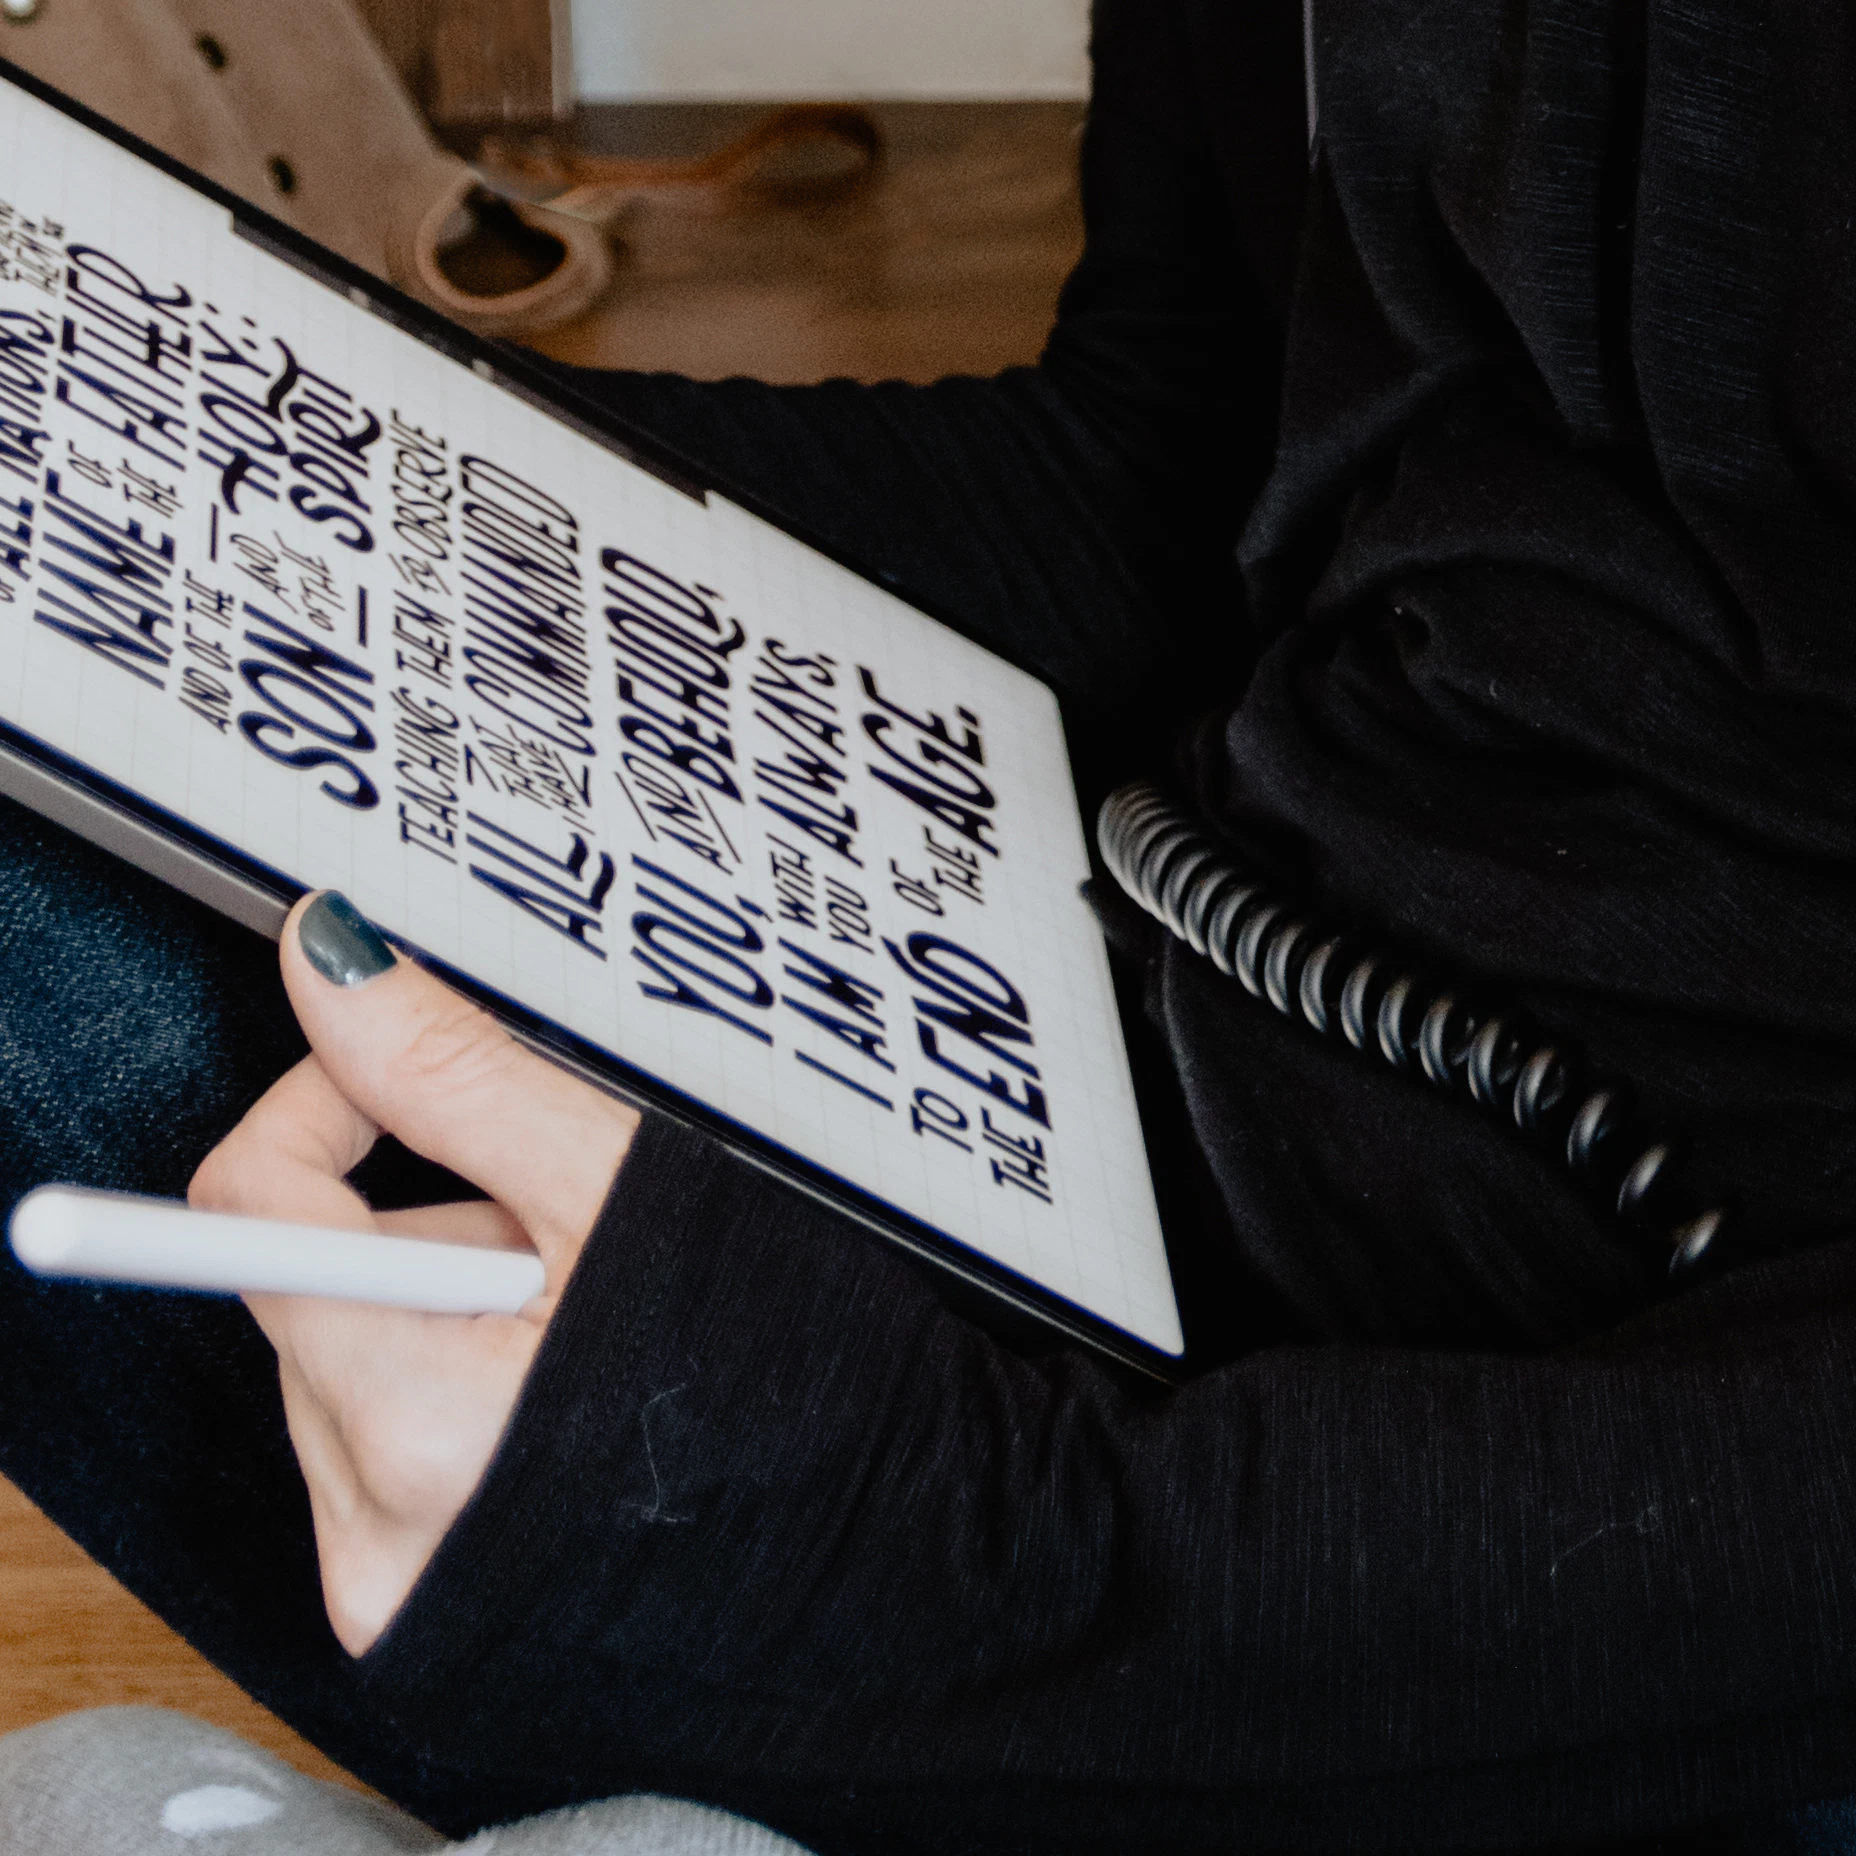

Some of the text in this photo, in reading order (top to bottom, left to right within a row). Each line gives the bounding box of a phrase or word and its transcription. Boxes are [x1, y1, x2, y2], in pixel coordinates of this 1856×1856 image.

[33, 243, 194, 692] NAME OF THE FATHER
[389, 408, 453, 562] OBSERVE
[178, 568, 236, 735] AND OF THE
[229, 533, 299, 615] AND
[393, 588, 456, 690] THEM
[459, 453, 598, 759] COMMANDED
[237, 600, 381, 811] SON
[391, 684, 461, 867] TEACHING
[506, 723, 586, 819] HAVE
[600, 545, 776, 1048] YOU, AND BEHOLD,
[466, 714, 616, 962] ALL THAT
[748, 636, 898, 1113] I AM WITH YOU ALWAYS,
[854, 662, 1055, 1206] TO THE END OF THE AGE.
